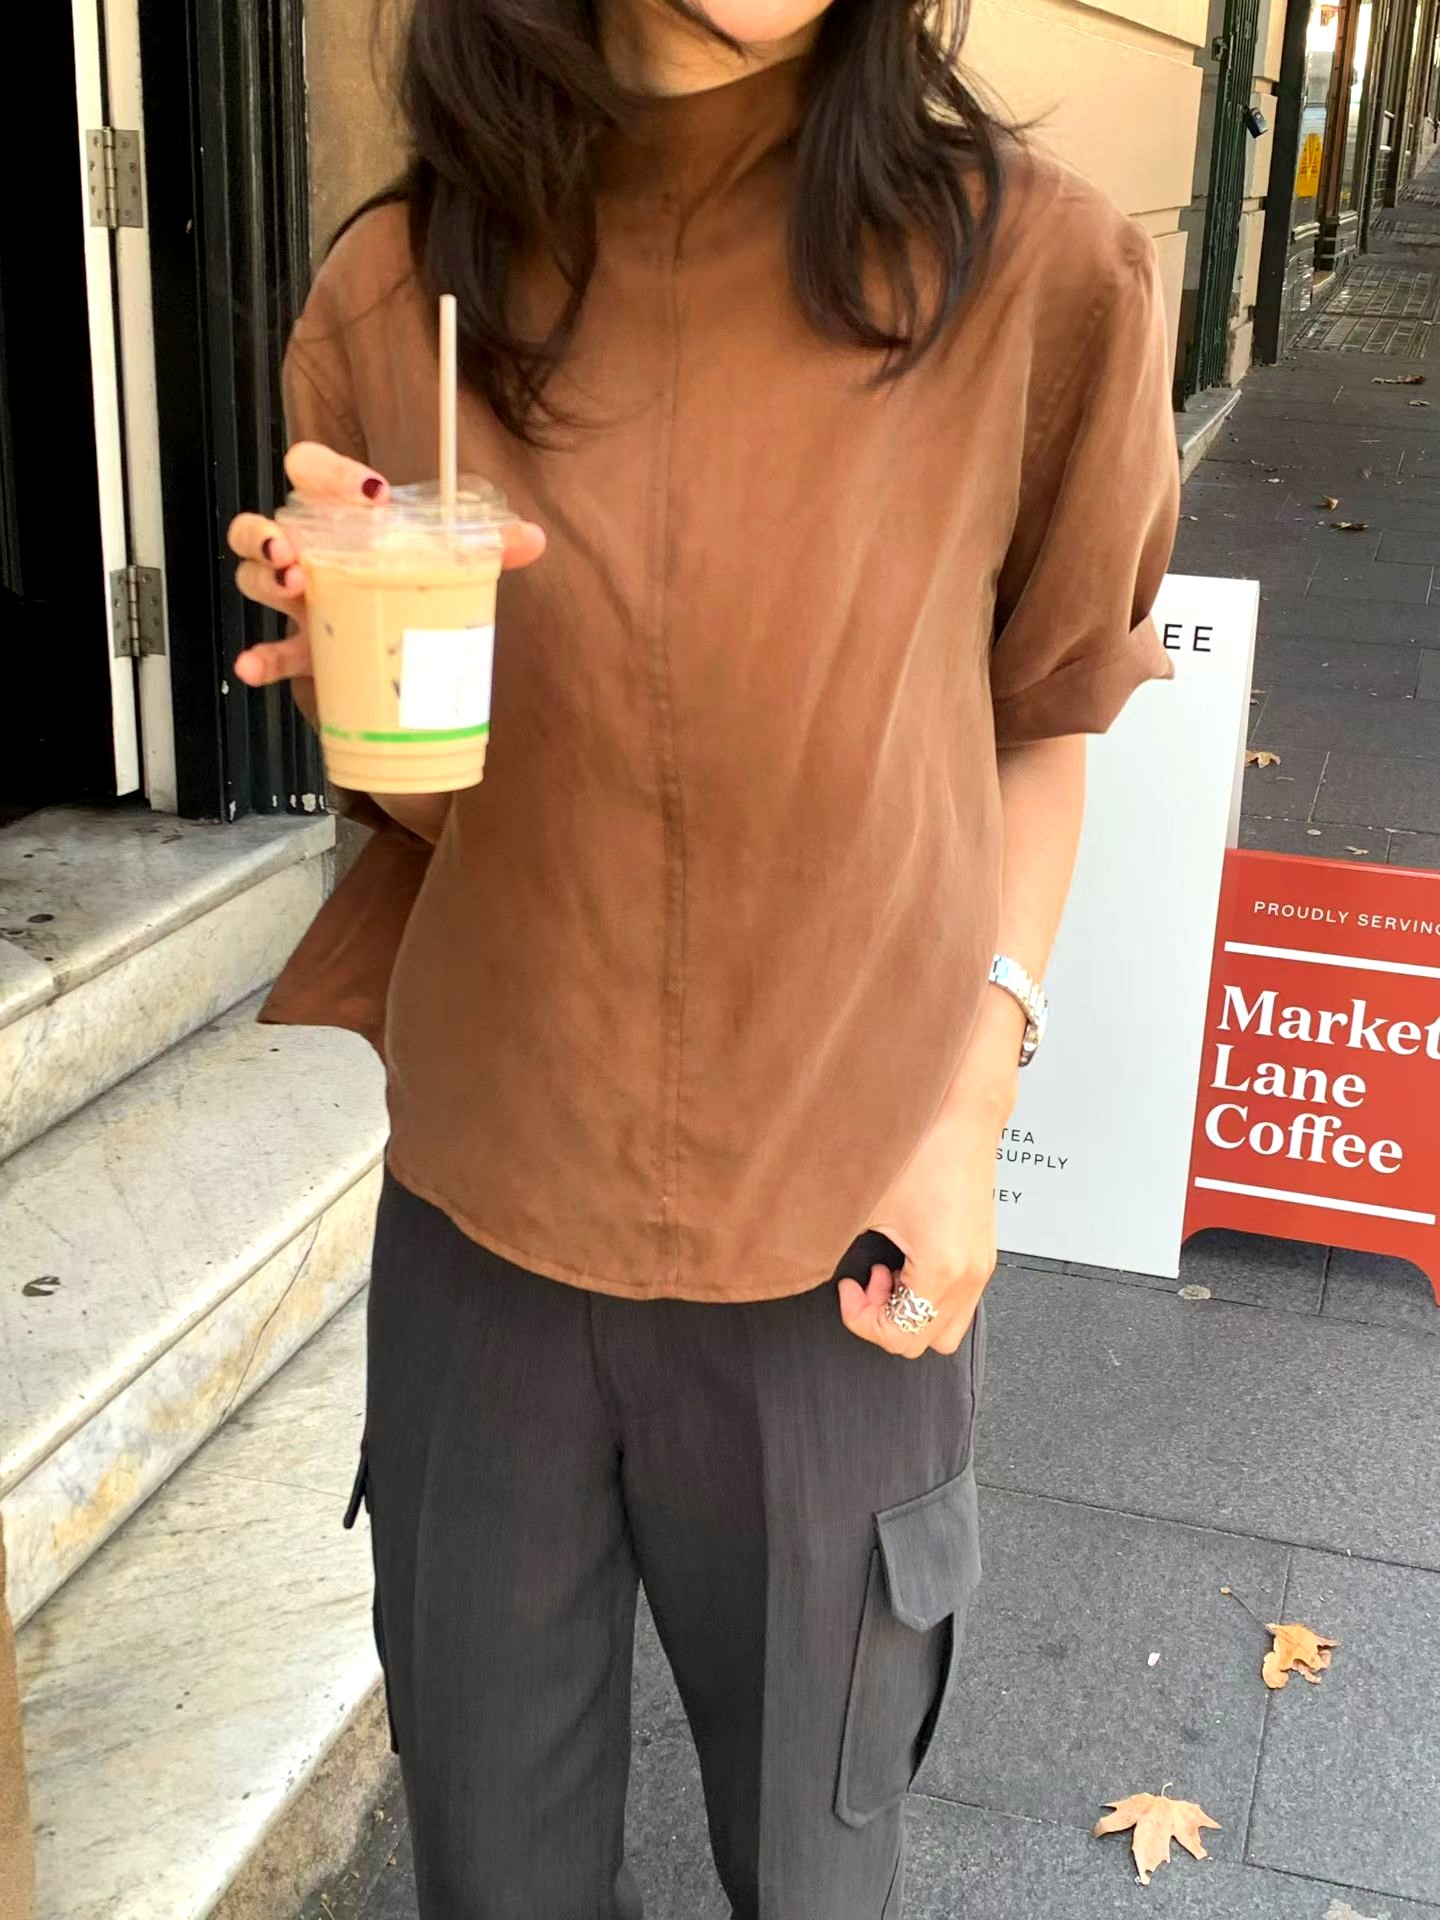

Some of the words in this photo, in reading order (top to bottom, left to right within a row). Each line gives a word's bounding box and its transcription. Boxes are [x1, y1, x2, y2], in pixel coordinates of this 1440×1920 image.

[1253, 901, 1349, 924] PROUDLY
[1216, 984, 1440, 1060] Market
[1210, 1043, 1366, 1108] Lane
[1001, 1127, 1035, 1144] TEA
[1204, 1103, 1403, 1174] Coffee
[995, 1147, 1068, 1170] SUPPLY
[992, 1188, 1022, 1204] EY
